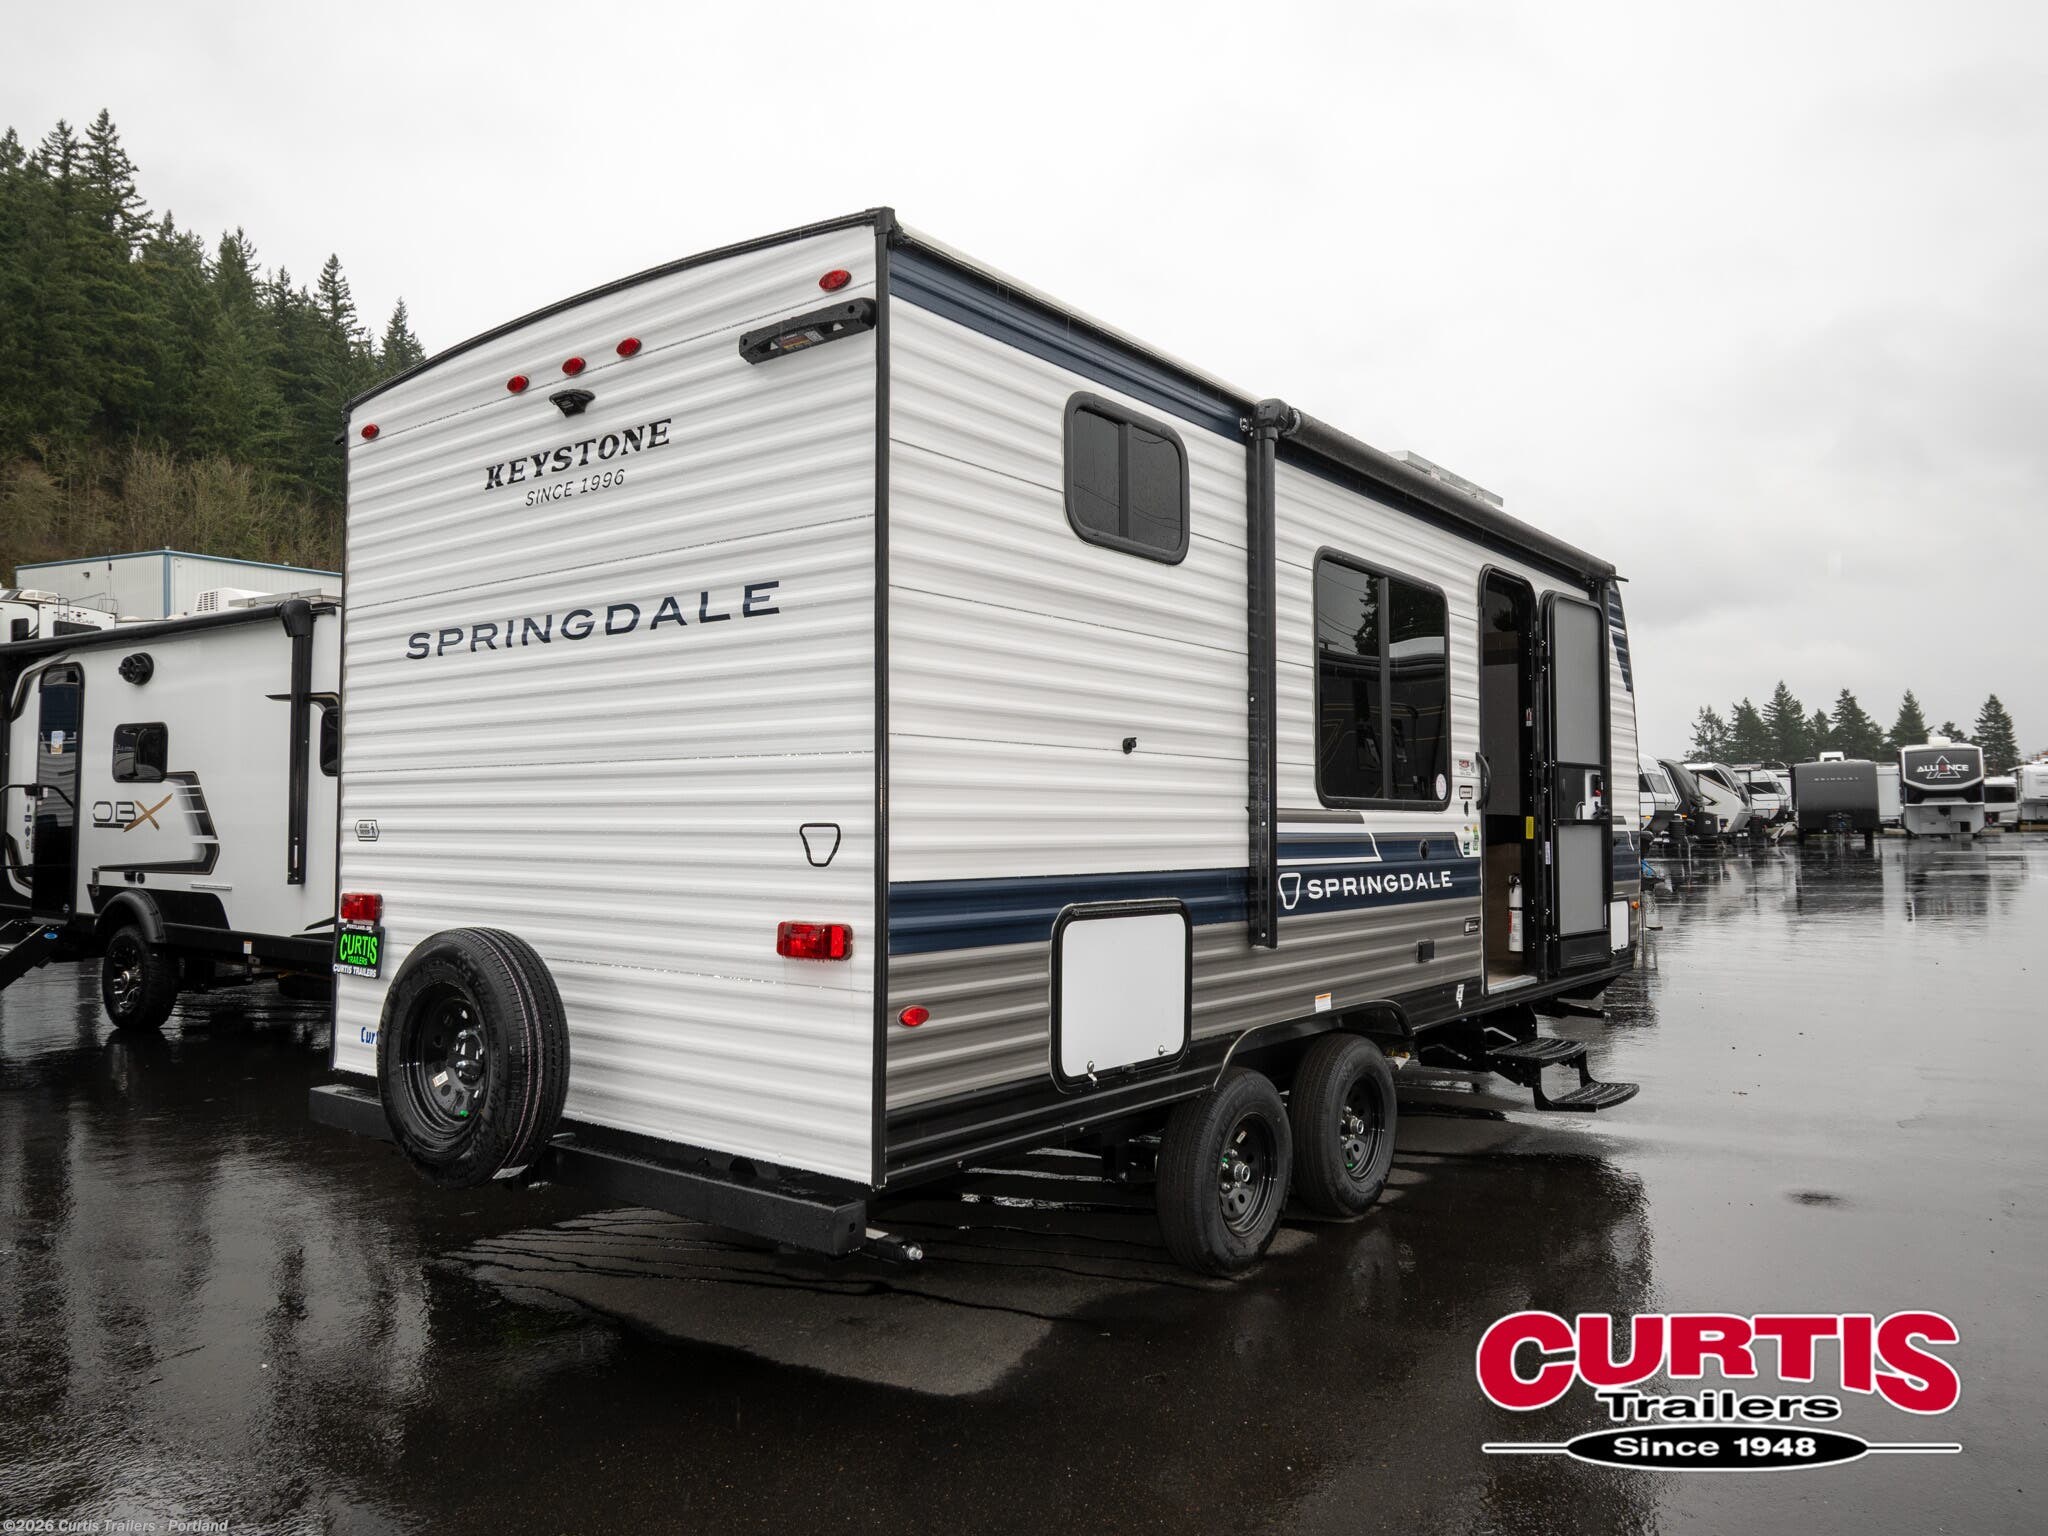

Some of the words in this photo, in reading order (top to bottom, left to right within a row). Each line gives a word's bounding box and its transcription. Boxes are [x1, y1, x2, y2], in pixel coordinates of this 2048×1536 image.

[484, 418, 672, 490] KEYSTONE
[525, 481, 574, 506] SINCE
[580, 468, 625, 494] 1996
[406, 581, 780, 660] SPRINGDALE
[93, 793, 173, 832] OBX
[1307, 871, 1453, 899] SPRINGDALE
[340, 933, 378, 964] CURTIS
[347, 955, 369, 965] TRAILERS
[333, 963, 352, 974] CURTIS
[353, 966, 377, 978] TRAILERS
